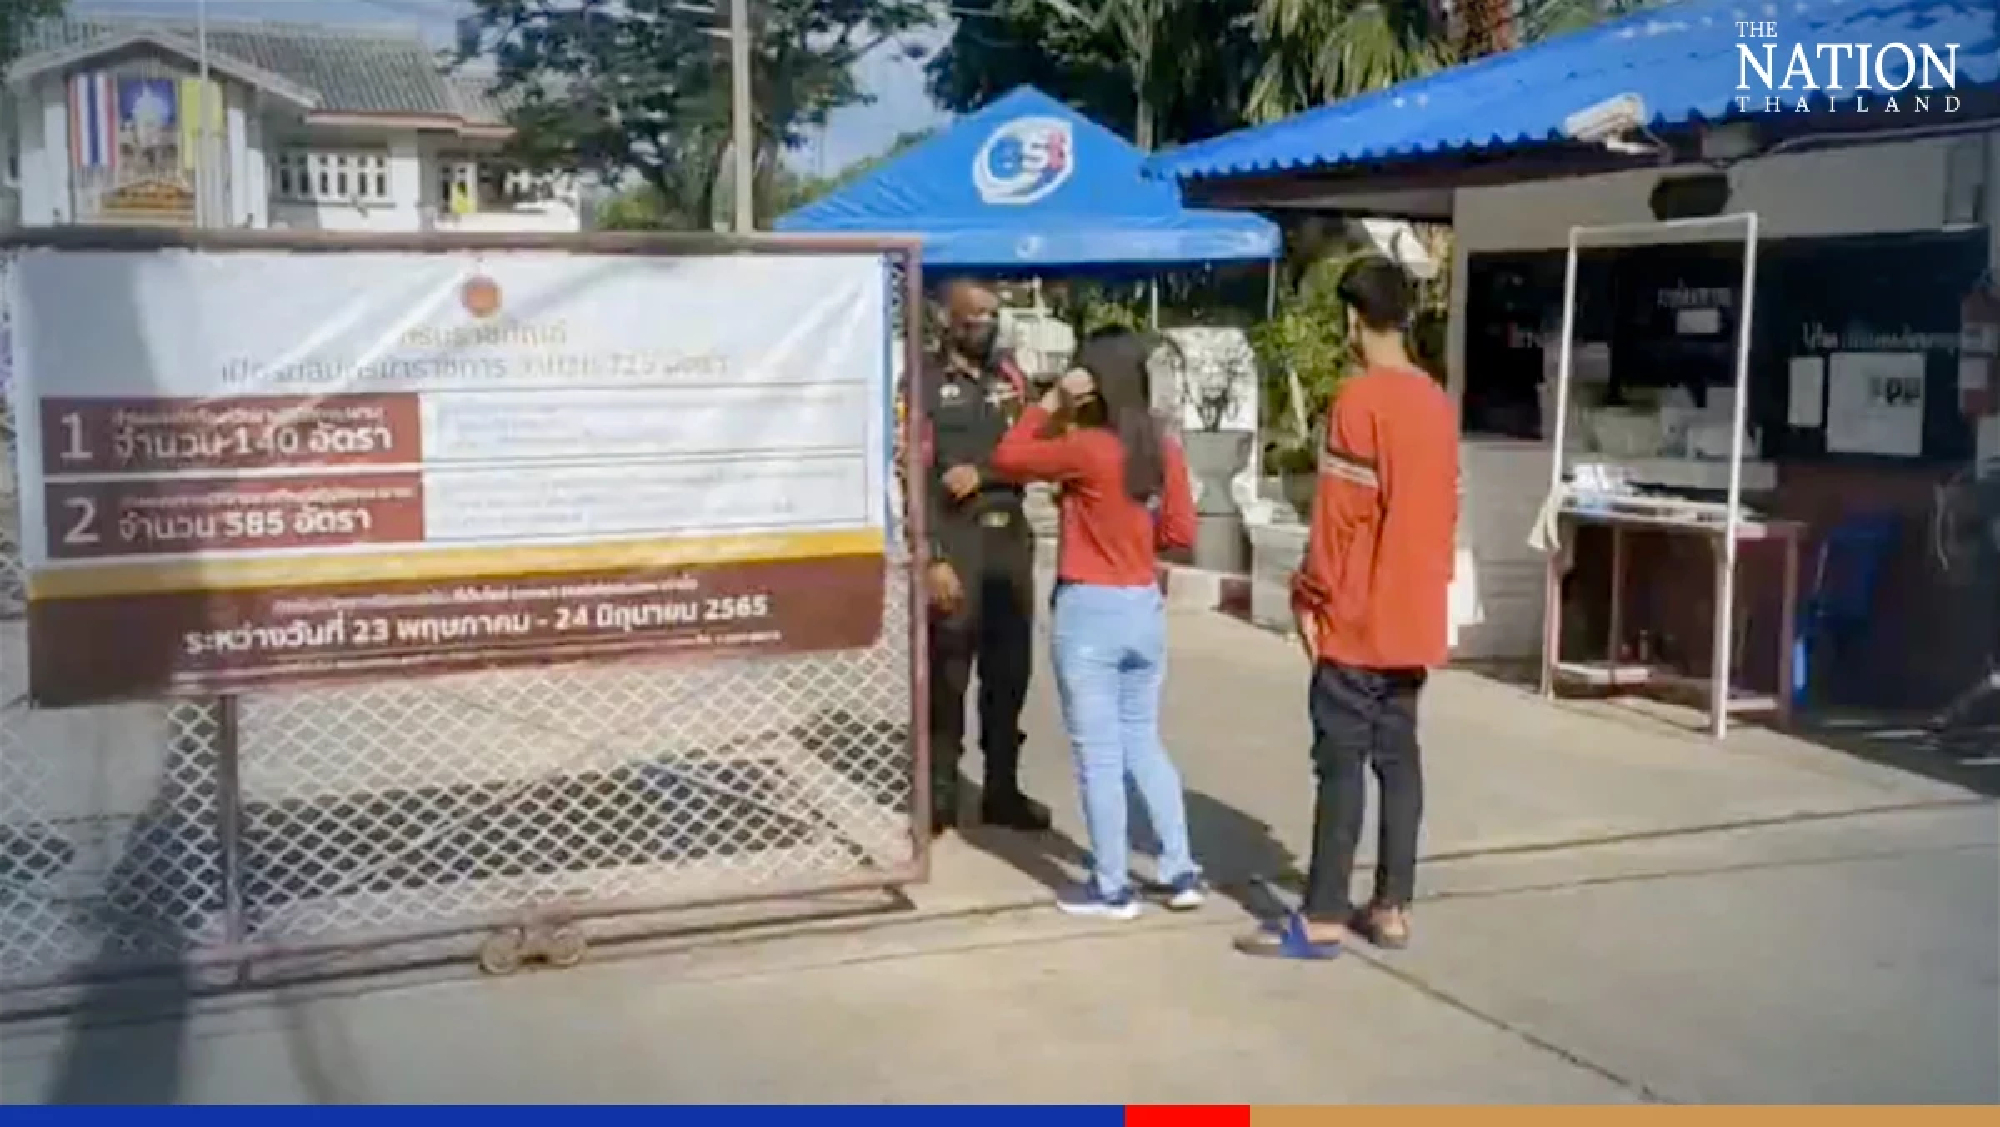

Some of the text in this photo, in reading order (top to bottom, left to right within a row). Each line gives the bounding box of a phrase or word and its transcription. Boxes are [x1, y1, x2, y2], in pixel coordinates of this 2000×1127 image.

[59, 411, 94, 460] 1
[113, 419, 393, 460] จำนวน 140 อัตรา
[62, 497, 99, 543] 2
[118, 504, 372, 541] จำนวน 585 อัตรา
[183, 610, 345, 655] ระหว่างวันที่
[352, 617, 389, 643] 23
[396, 611, 532, 644] พฤษภาคม
[554, 604, 589, 631] 24
[596, 601, 699, 632] มิถุนายน
[703, 594, 769, 621] 2565
